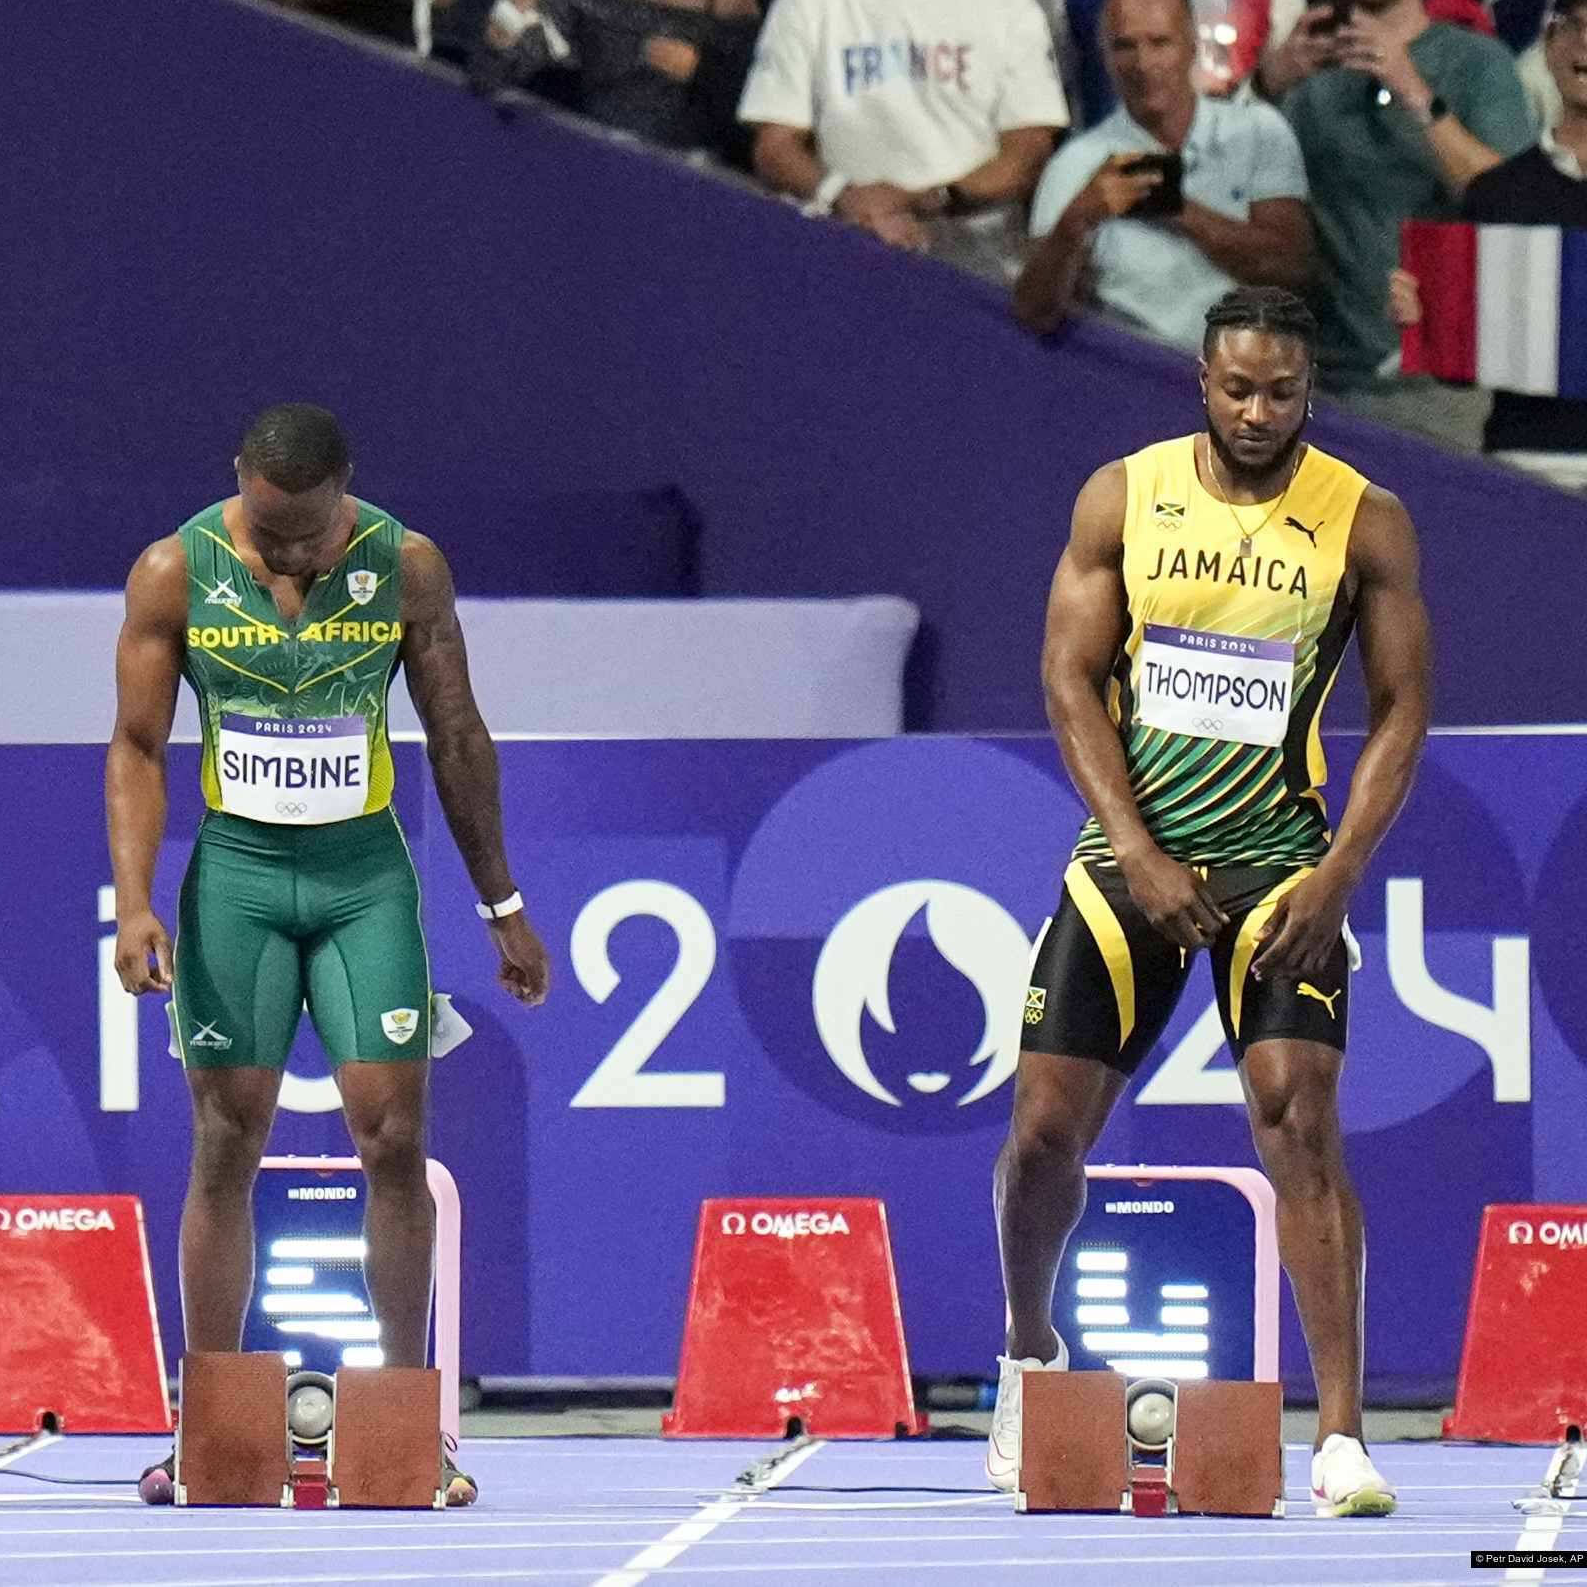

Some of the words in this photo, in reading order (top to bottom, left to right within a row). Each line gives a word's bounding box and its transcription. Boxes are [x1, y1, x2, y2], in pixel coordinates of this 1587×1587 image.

[1147, 548, 1308, 599] JAMAICA
[188, 625, 280, 648] SOUTH
[300, 621, 403, 642] AFRICA
[1179, 633, 1217, 649] PARIS
[1221, 639, 1256, 653] 2024
[1145, 661, 1287, 712] THOMPSON
[255, 721, 294, 735] PARIS
[298, 723, 332, 735] 2024
[223, 750, 361, 789] SIMBINE
[299, 1187, 357, 1200] MONDO
[15, 1208, 115, 1231] OMEGA
[1116, 1201, 1175, 1214] MONDO
[751, 1212, 850, 1237] OMEGA
